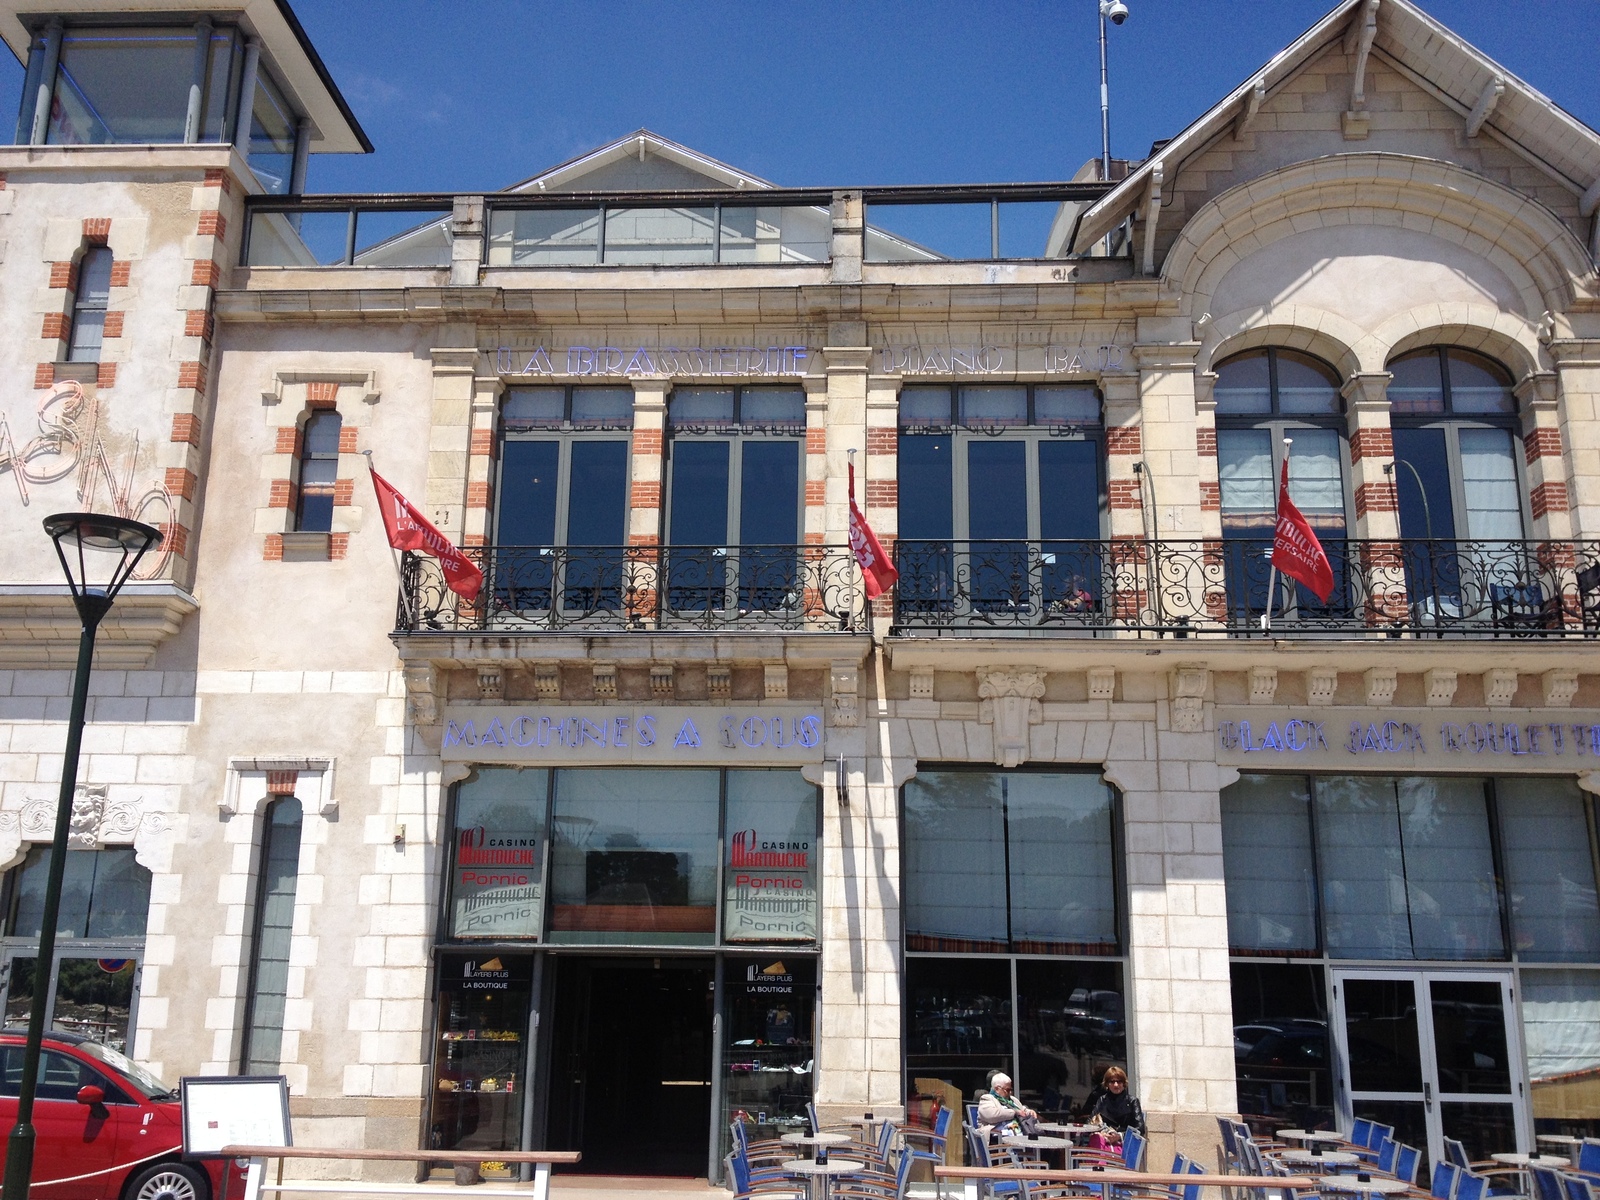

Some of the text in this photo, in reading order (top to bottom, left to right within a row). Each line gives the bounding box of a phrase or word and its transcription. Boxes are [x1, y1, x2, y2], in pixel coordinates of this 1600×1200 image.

[883, 344, 1123, 373] PIANO BAR
[443, 715, 821, 749] MACHINES A SOUS
[1219, 719, 1329, 753] BLACK
[1344, 719, 1426, 755] JACK
[458, 826, 535, 865] PARTOUCHE
[490, 838, 536, 847] CASINO
[731, 828, 808, 868] PARTOUCHE
[762, 841, 809, 850] CASINO
[462, 872, 528, 885] Pornic
[735, 875, 803, 889] Pornic
[467, 908, 531, 932] Pornic
[740, 915, 806, 932] Pornic
